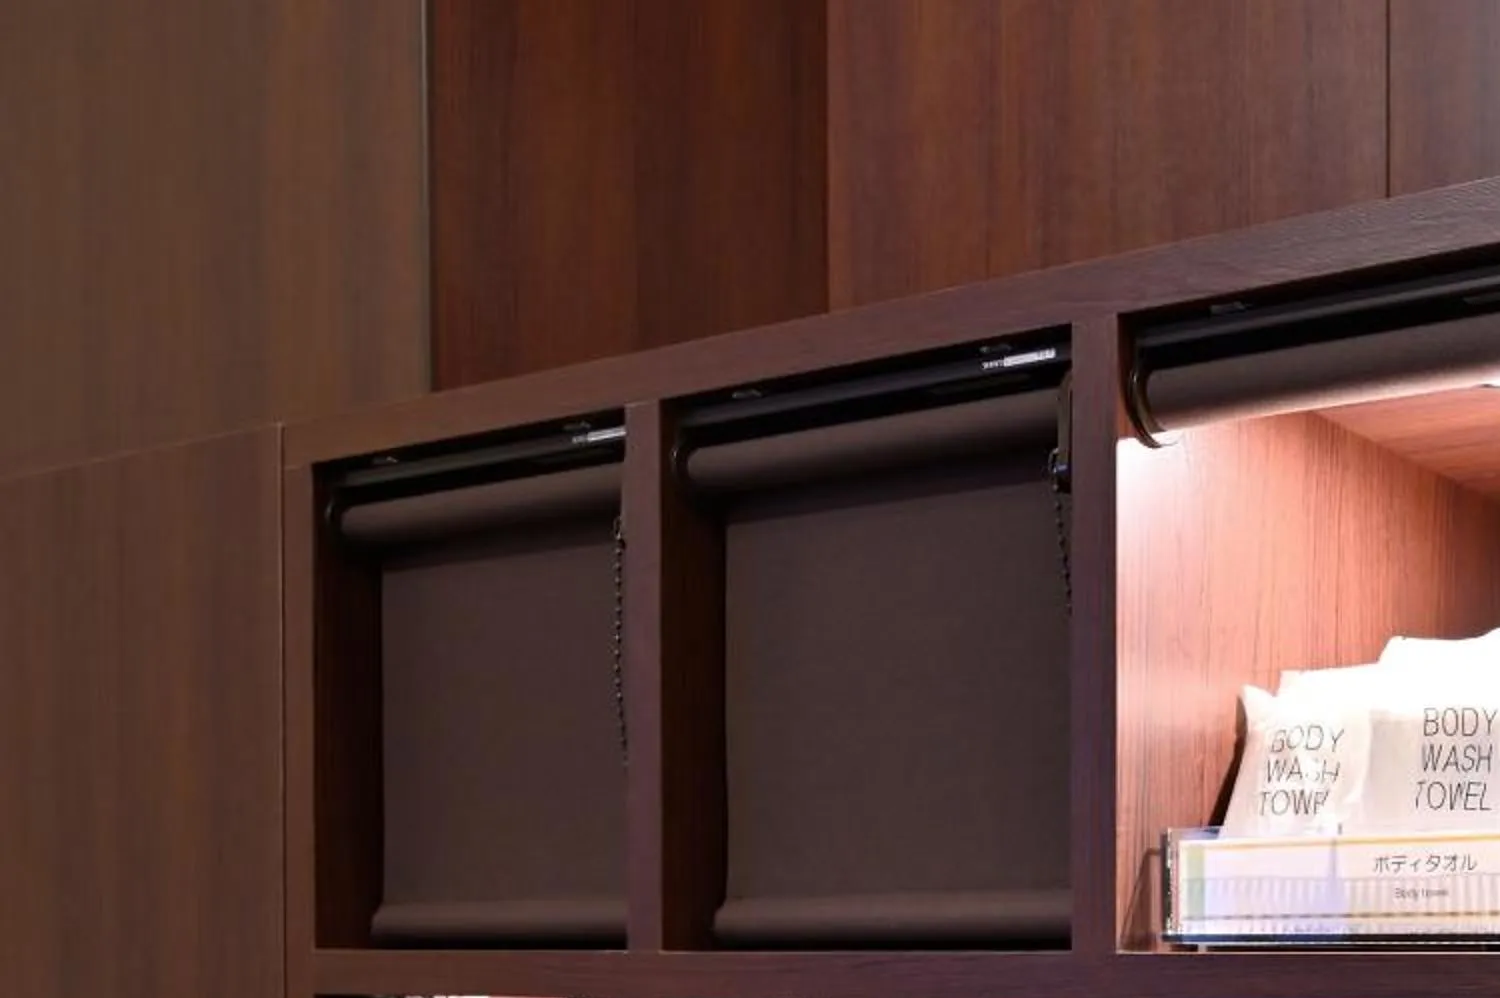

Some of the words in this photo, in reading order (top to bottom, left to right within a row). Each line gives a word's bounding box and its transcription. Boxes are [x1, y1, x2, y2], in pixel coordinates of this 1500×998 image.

[1423, 706, 1497, 737] BODY
[1270, 724, 1345, 753] BODY
[1421, 743, 1493, 772] WASH
[1414, 781, 1492, 811] TOWEL
